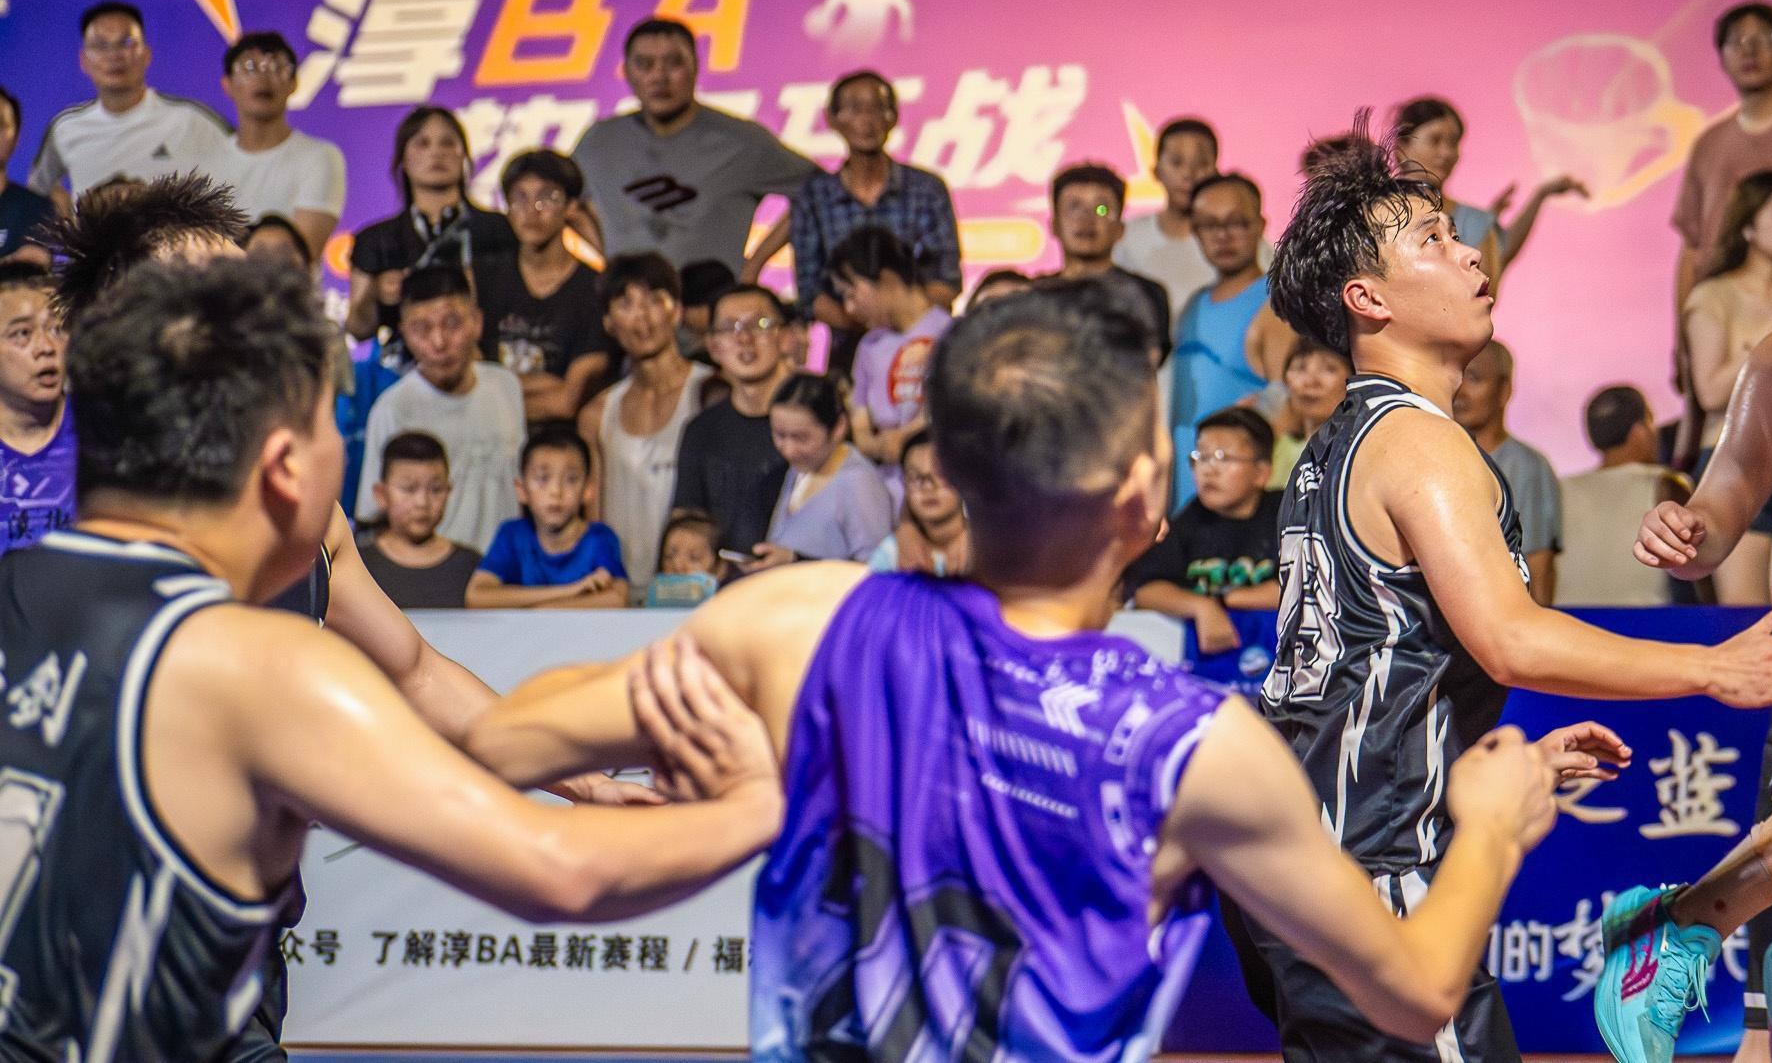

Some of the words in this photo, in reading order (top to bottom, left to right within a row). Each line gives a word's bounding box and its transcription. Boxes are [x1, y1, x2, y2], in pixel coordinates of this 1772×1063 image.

[371, 931, 670, 972] 了解淳BA最新赛程
[712, 936, 752, 974] 福
